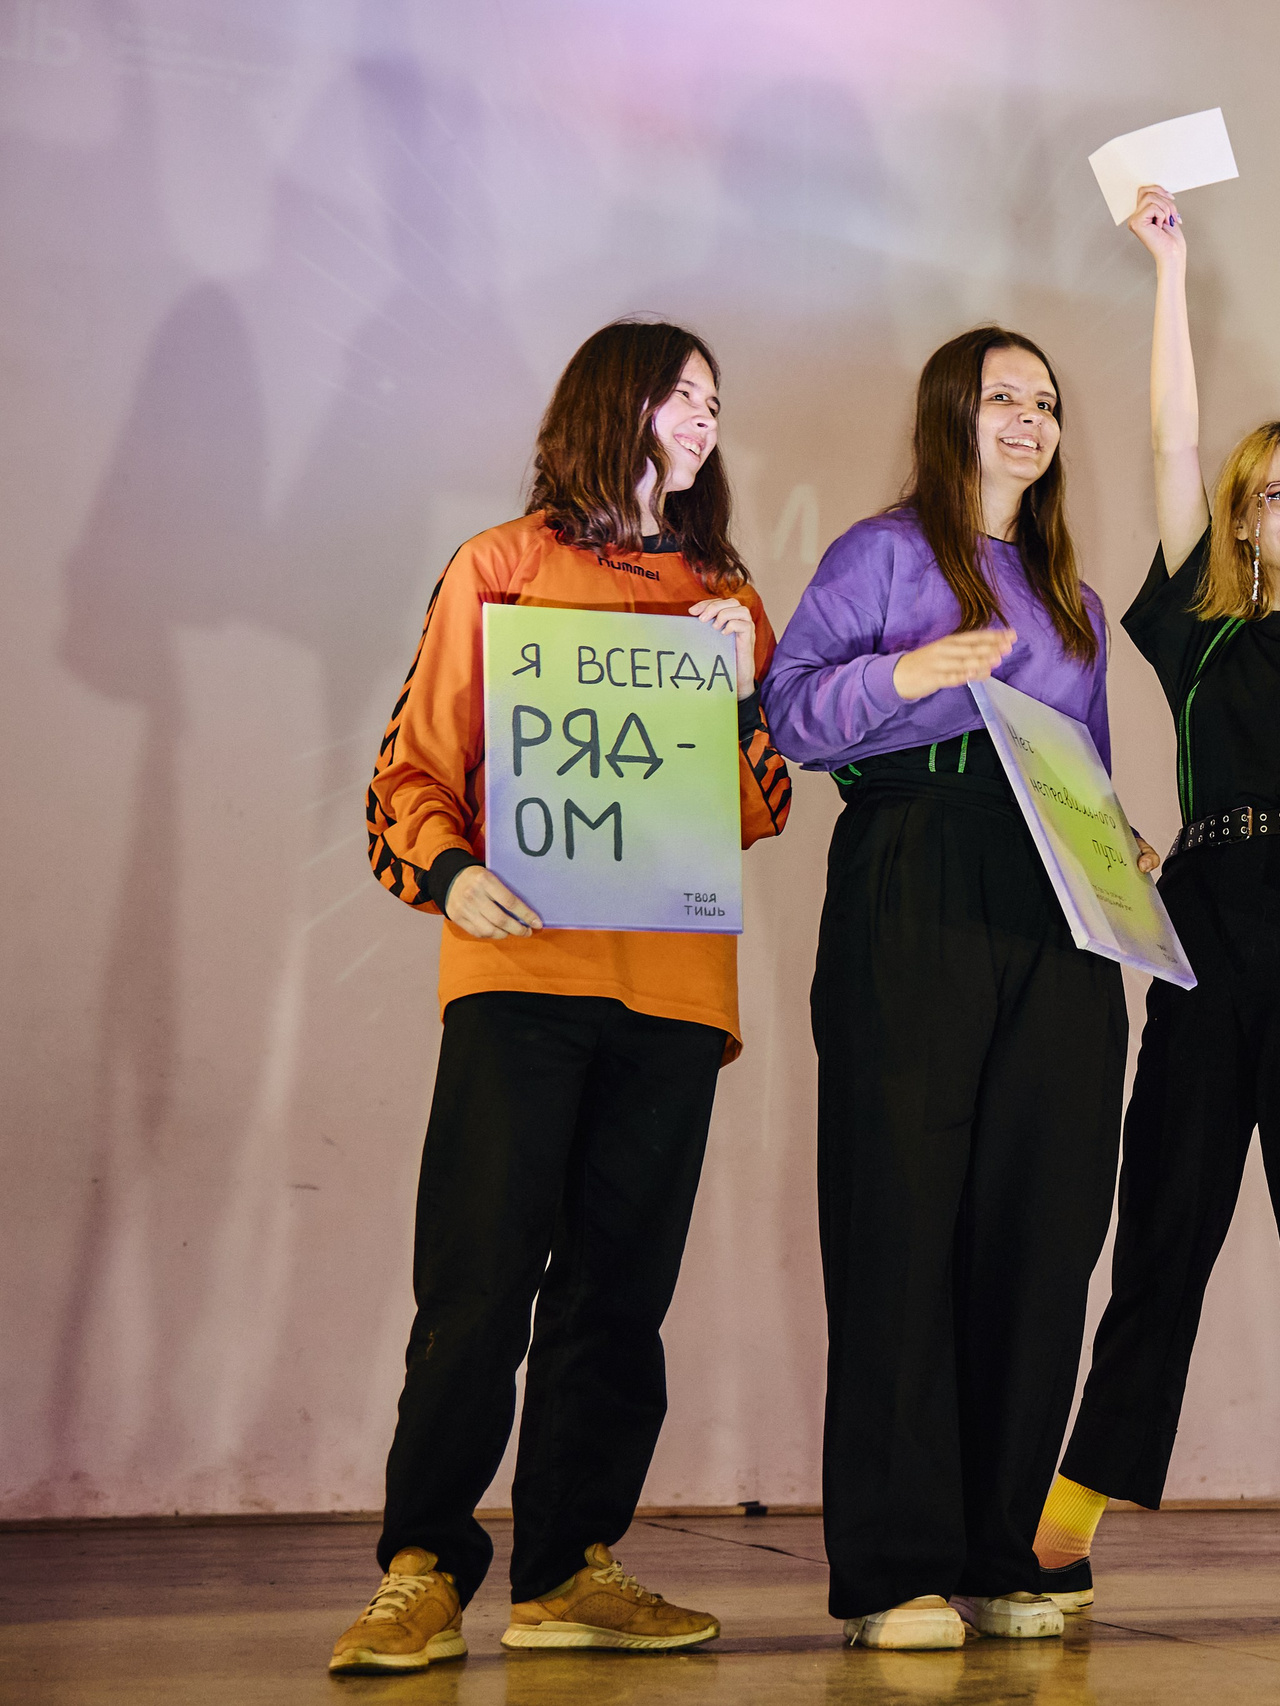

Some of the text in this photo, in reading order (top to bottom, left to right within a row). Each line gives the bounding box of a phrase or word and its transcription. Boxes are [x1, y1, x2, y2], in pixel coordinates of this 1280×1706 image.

[597, 555, 660, 581] hummel
[512, 643, 734, 692] Я ВСЕГДА
[515, 797, 623, 862] ОМ
[1092, 839, 1127, 872] пути
[684, 892, 717, 904] ТВОЯ
[684, 904, 726, 917] ТИШЬ
